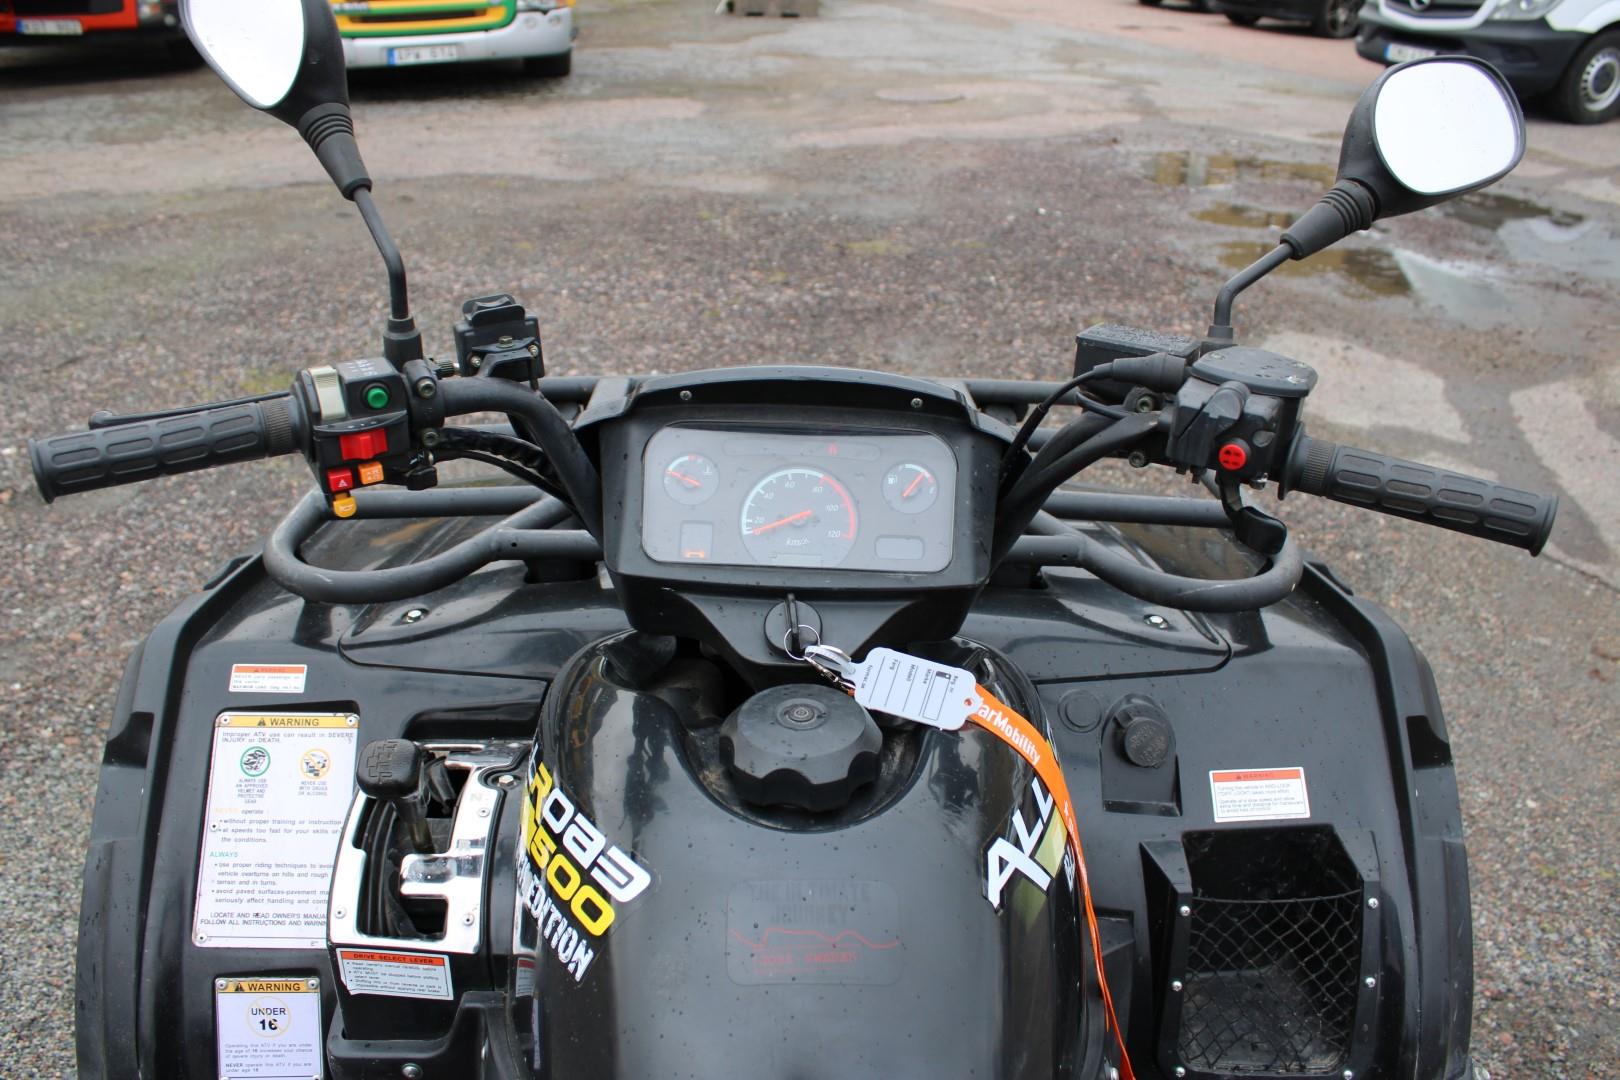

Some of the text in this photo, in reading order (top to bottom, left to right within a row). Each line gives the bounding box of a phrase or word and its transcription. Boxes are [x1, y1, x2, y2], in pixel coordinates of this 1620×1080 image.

[786, 537, 810, 546] km/h
[270, 718, 319, 726] WARNING
[974, 696, 1041, 766] arMobility
[248, 982, 300, 992] WARNING
[251, 1007, 286, 1016] UNDER
[259, 1019, 278, 1031] 16
